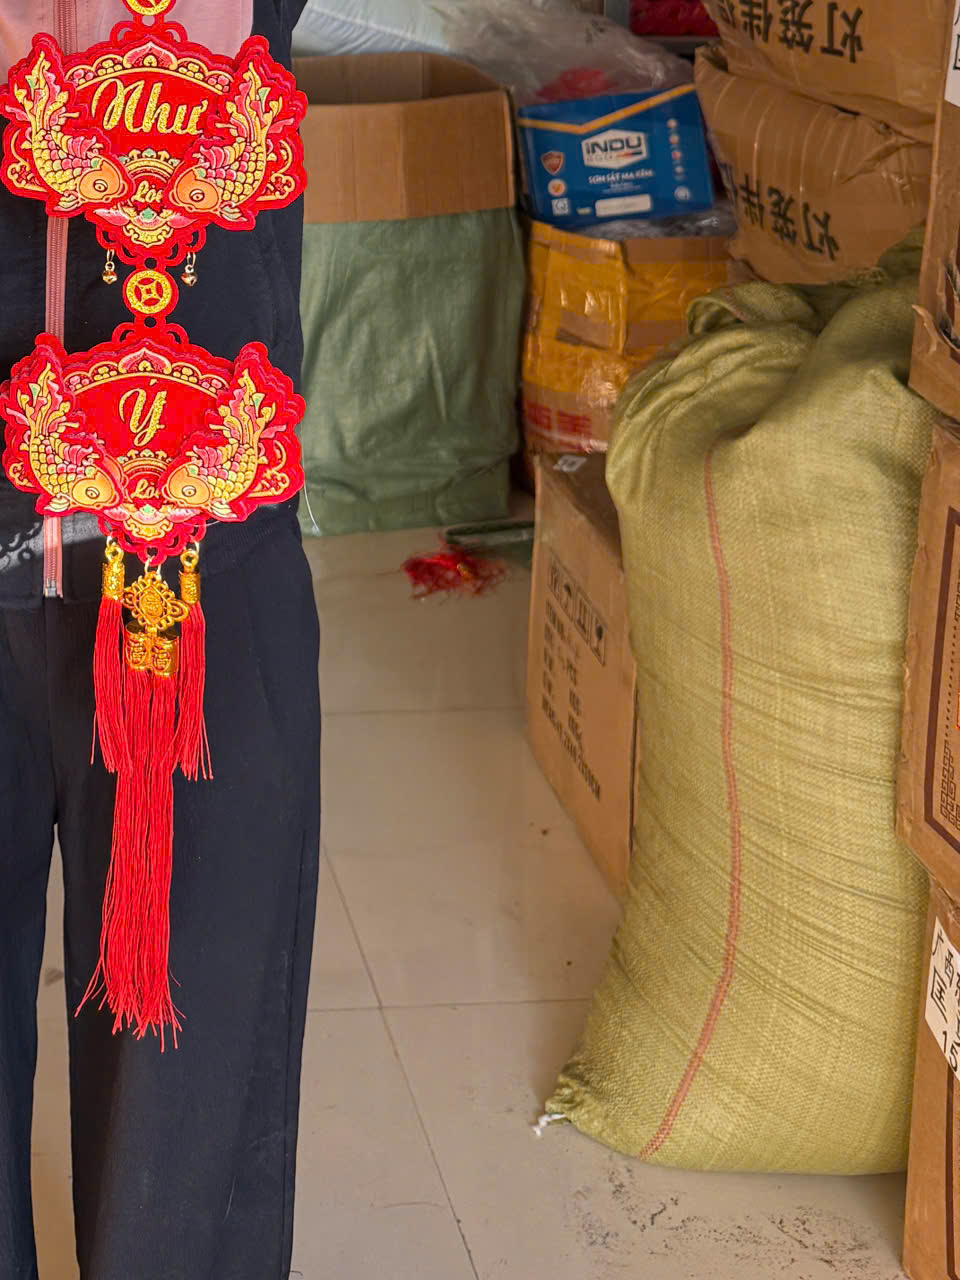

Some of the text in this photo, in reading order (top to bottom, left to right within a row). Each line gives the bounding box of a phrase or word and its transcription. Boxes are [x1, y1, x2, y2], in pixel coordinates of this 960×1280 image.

[91, 79, 209, 136] Như
[720, 164, 839, 261] 灯笼伴
[118, 379, 168, 446] Ý
